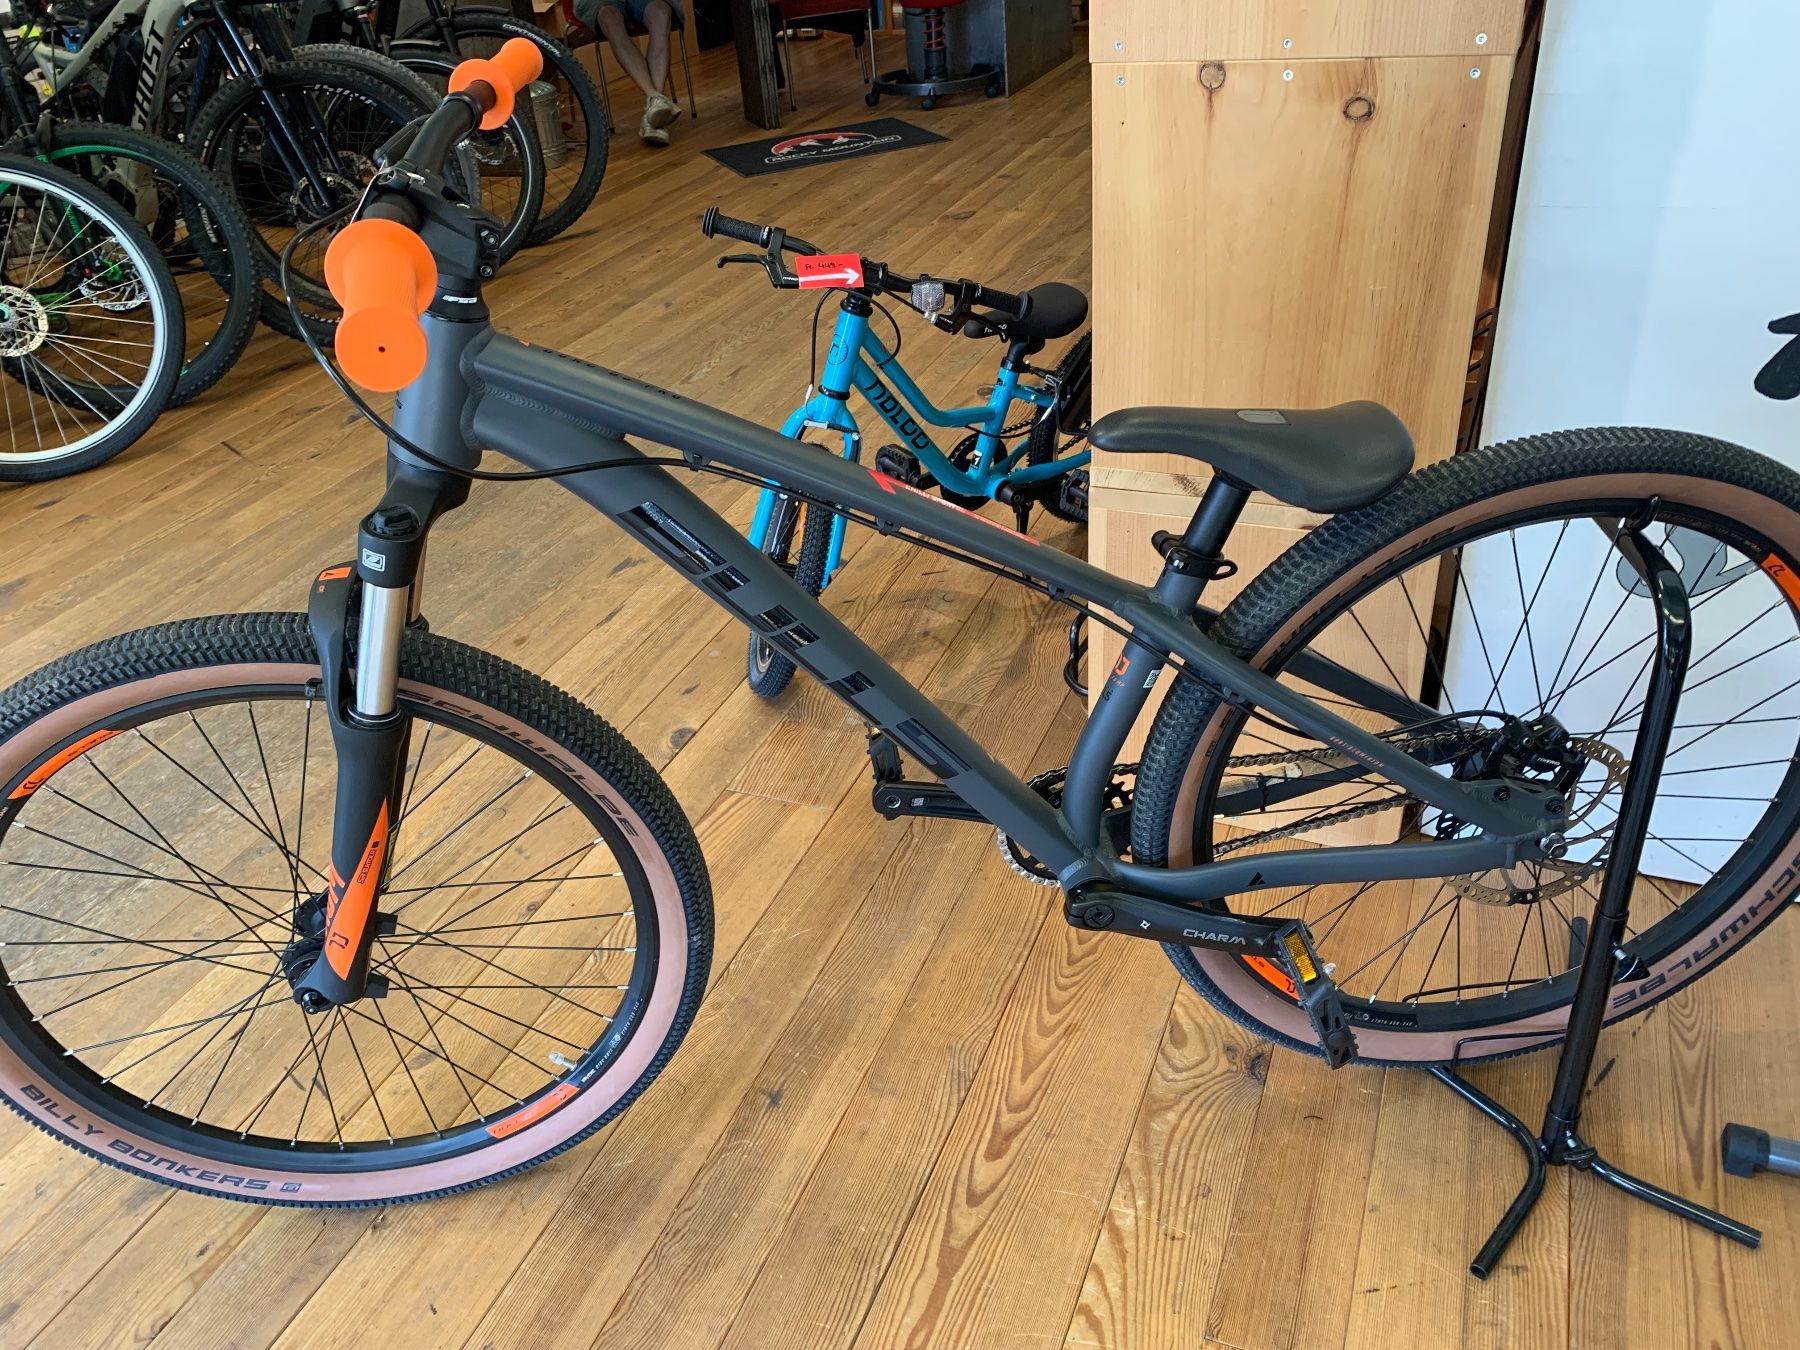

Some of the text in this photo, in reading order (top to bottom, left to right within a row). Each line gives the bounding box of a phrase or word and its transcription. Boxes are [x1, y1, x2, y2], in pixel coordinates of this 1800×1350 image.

[502, 23, 561, 58] CONTINENTAL
[772, 136, 896, 162] ROCKY MOUNTAIN
[616, 501, 973, 781] BULLS
[395, 688, 641, 838] SCHWALBE
[1182, 927, 1247, 946] CHARM
[20, 1083, 271, 1191] BILLY BONKERS
